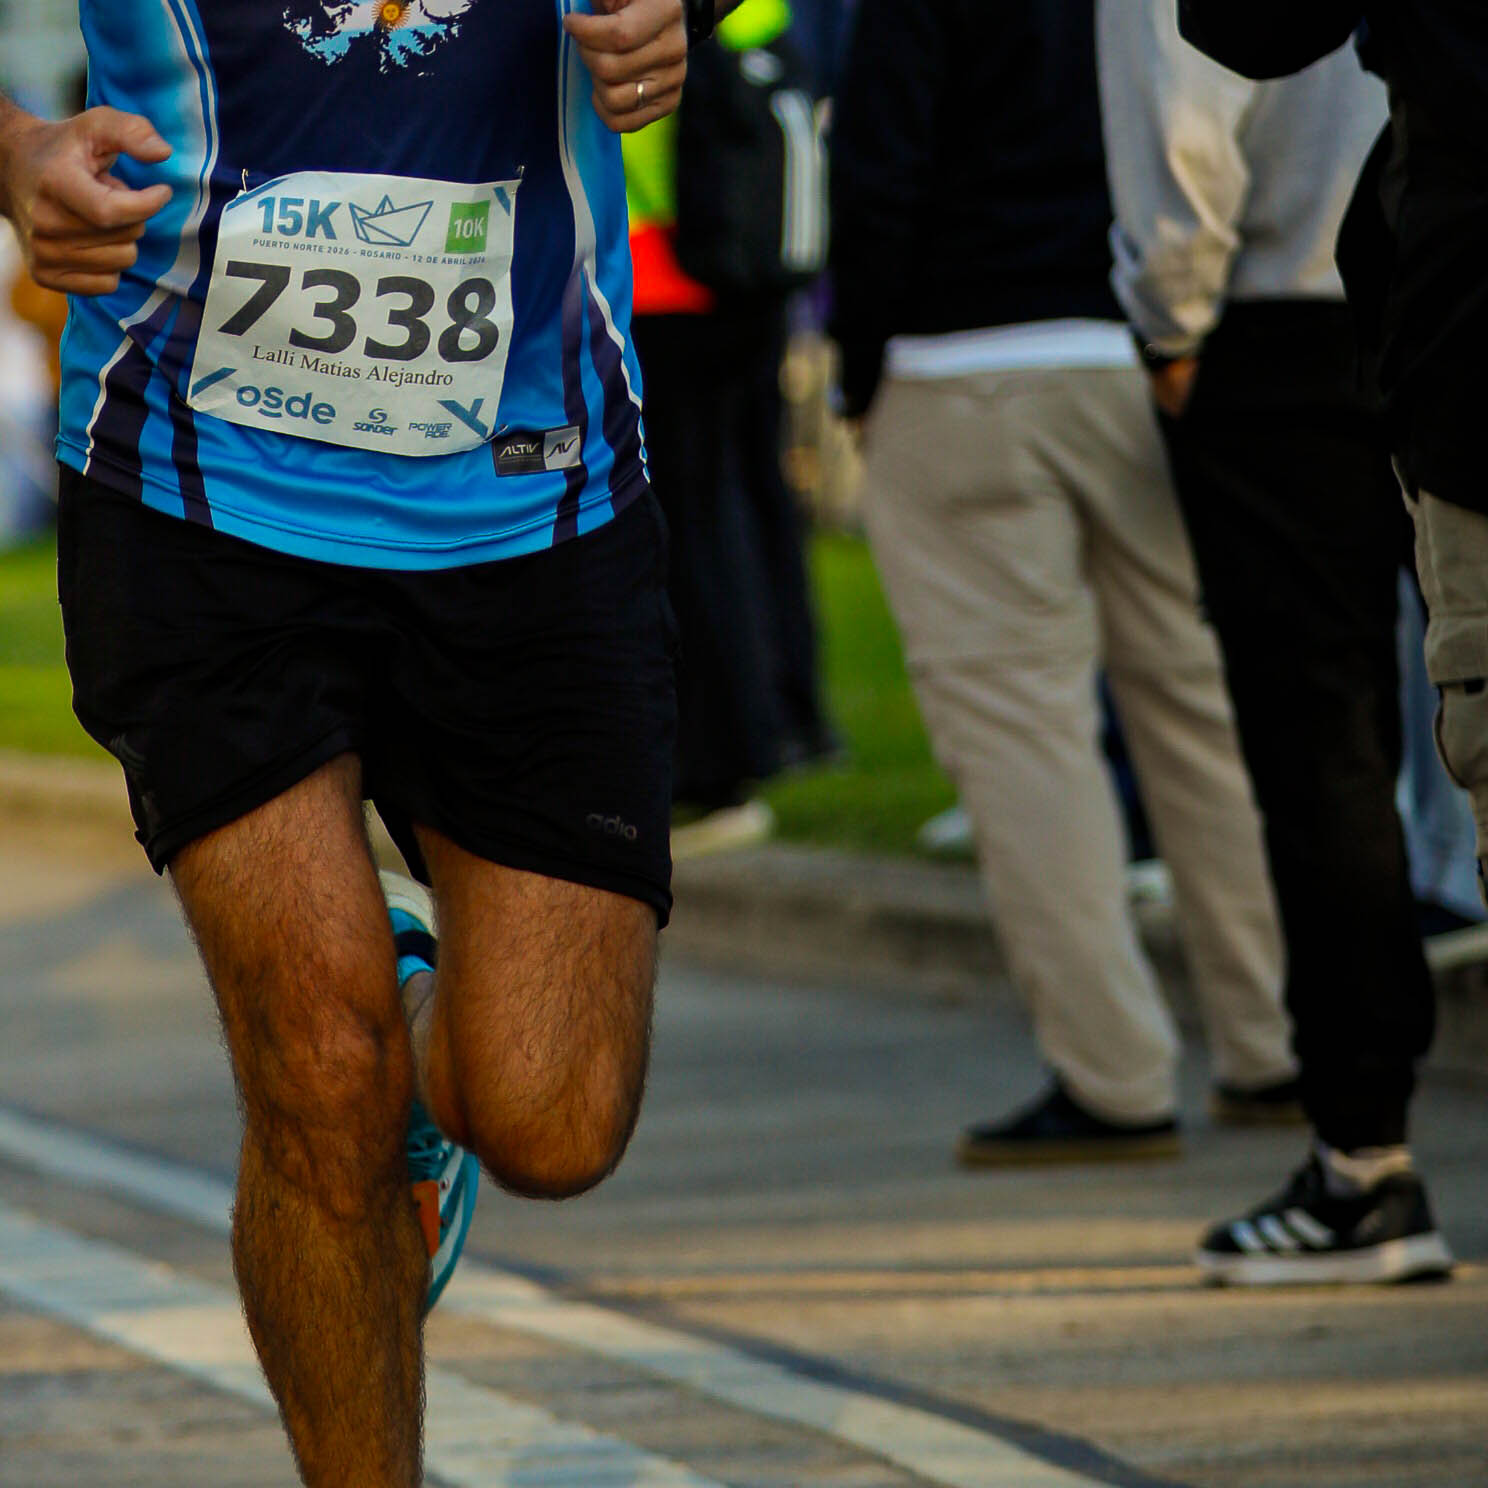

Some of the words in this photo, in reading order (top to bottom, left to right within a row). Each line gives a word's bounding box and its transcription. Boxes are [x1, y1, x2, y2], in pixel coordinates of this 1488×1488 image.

[256, 194, 342, 240] 15K
[454, 216, 485, 240] 10K
[252, 238, 290, 249] PUERTO
[293, 243, 324, 253] NORTE
[359, 249, 402, 261] ROSARIO
[412, 254, 423, 264] 12
[426, 255, 438, 264] DE
[441, 256, 467, 265] ABRIL
[217, 260, 500, 363] 7338
[252, 344, 296, 367] Lalli
[300, 354, 362, 380] Matias
[366, 365, 454, 388] Alejandro
[236, 385, 337, 425] osde
[408, 422, 452, 432] POWER
